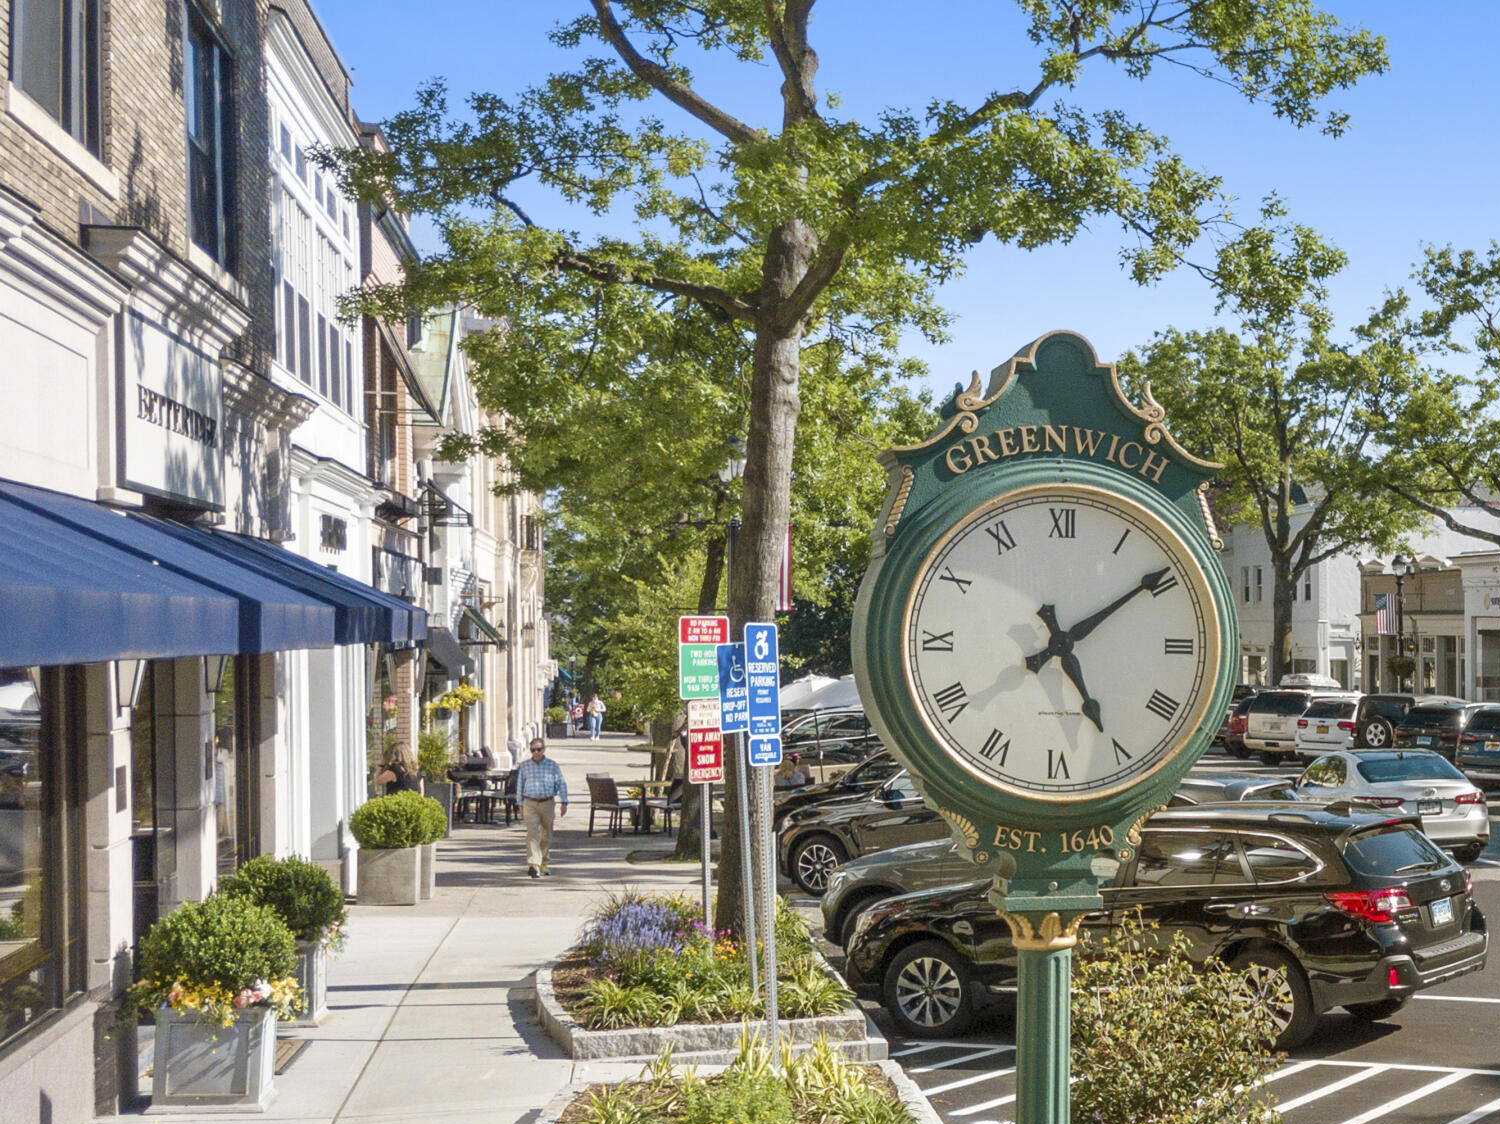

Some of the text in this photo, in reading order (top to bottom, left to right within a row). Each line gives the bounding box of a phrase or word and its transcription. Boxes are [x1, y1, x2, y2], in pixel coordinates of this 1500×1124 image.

[136, 383, 217, 448] BETTERIDGE
[946, 424, 1170, 484] GREENWICH
[1049, 508, 1076, 538] XII
[986, 520, 1016, 555] XI
[1113, 529, 1130, 555] I
[940, 566, 971, 594] X
[1165, 638, 1193, 655] III
[748, 662, 777, 673] RESERVED
[750, 676, 775, 687] PARKING
[690, 732, 720, 743] TOW AWAY
[760, 743, 772, 752] VAN
[697, 753, 715, 765] SNOW
[1048, 749, 1070, 779] VI
[1112, 738, 1133, 765] V
[992, 825, 1114, 853] EST. 1640
